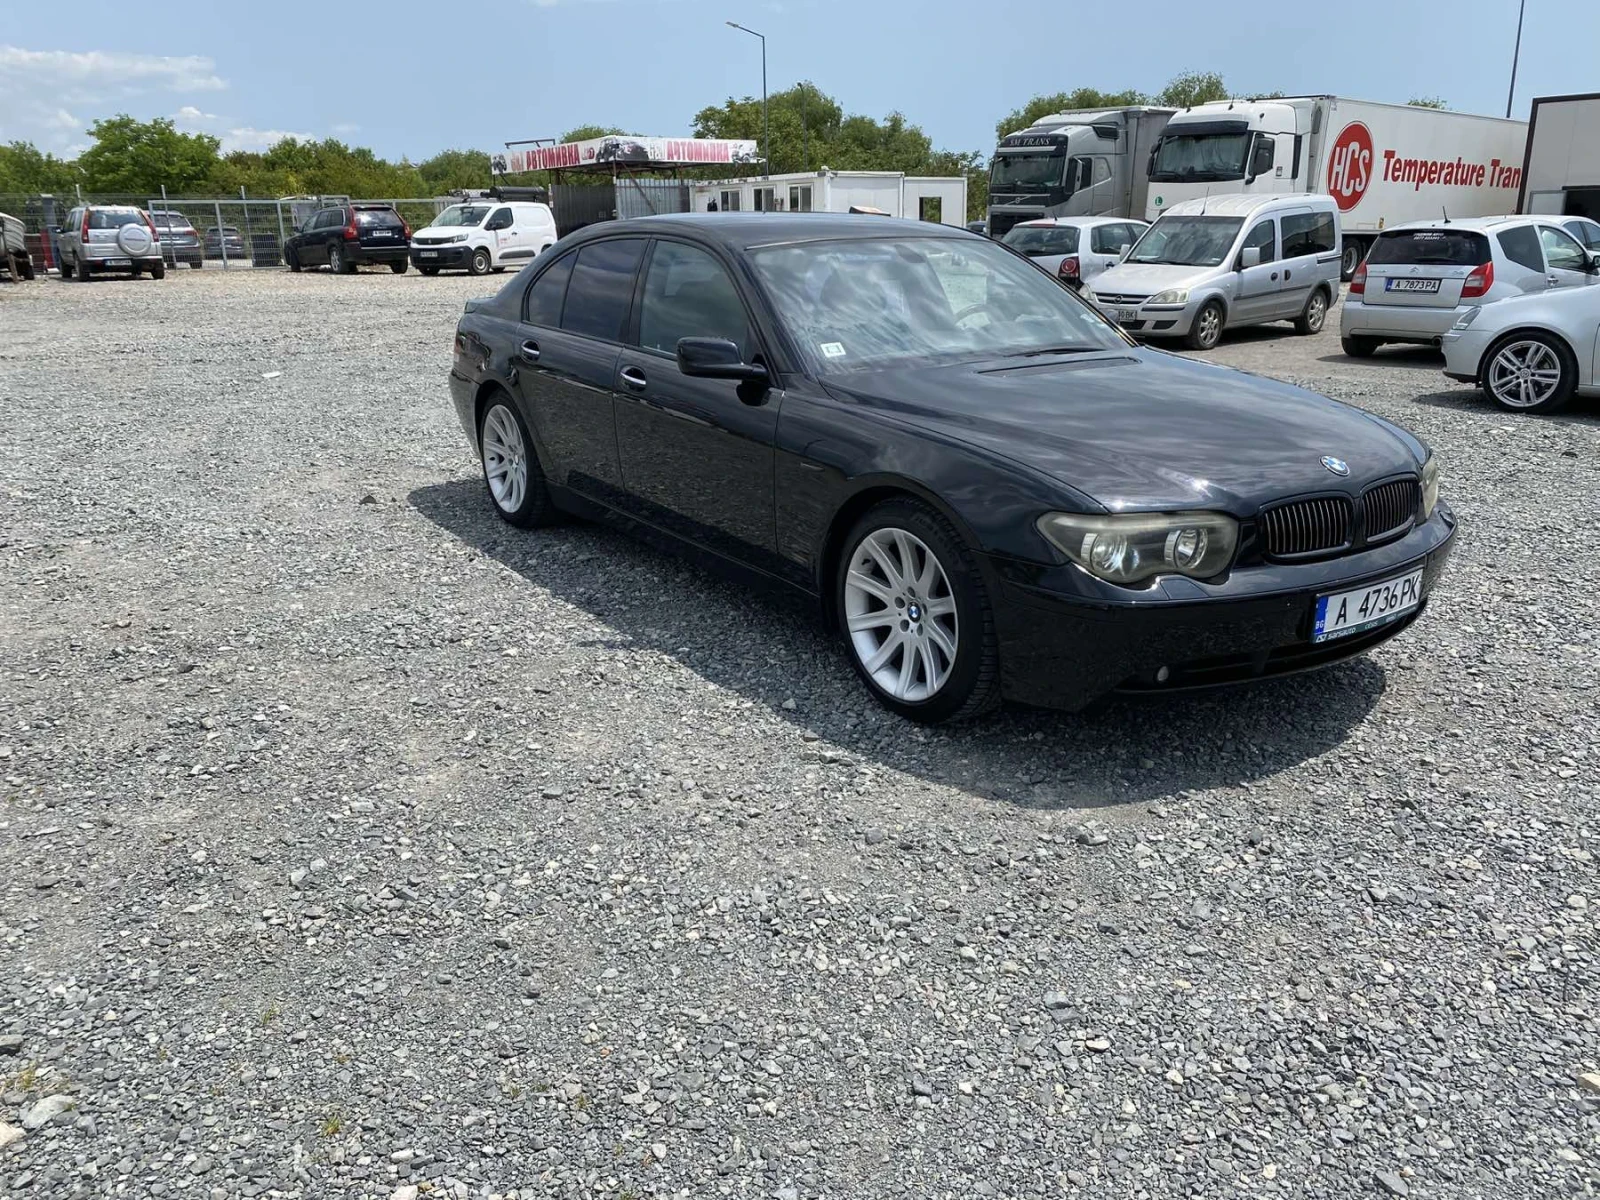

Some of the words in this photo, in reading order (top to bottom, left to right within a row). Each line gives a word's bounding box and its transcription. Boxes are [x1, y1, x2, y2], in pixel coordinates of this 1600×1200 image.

[1023, 137, 1051, 146] TRANS
[526, 144, 580, 170] АВТОМИВКА
[1330, 141, 1370, 197] HCS
[1383, 150, 1485, 191] Temperature
[1315, 620, 1324, 629] BG
[1335, 597, 1347, 625] A
